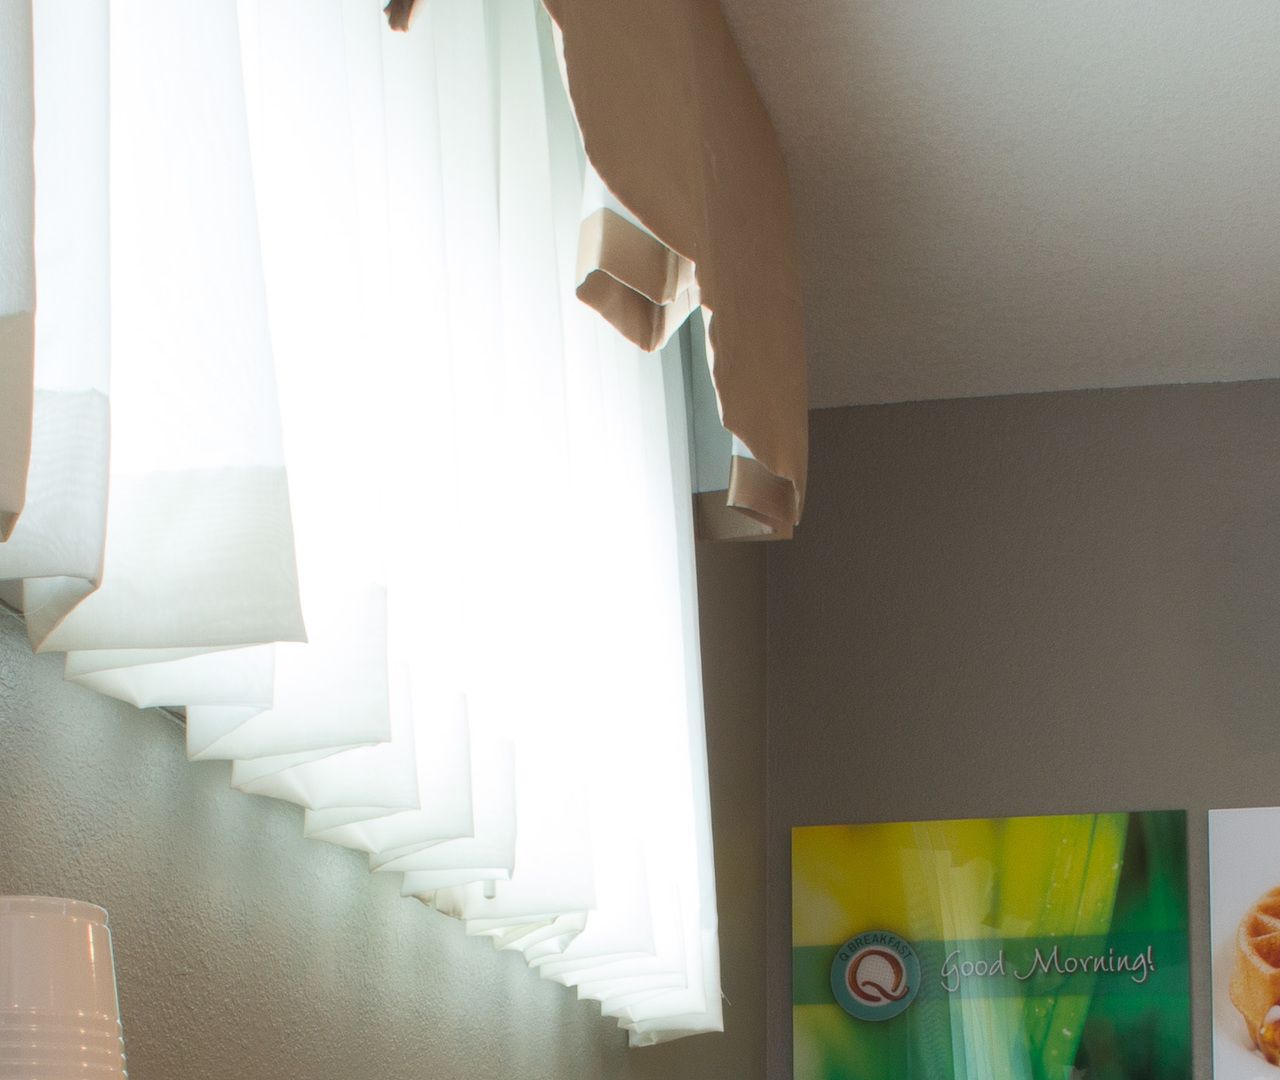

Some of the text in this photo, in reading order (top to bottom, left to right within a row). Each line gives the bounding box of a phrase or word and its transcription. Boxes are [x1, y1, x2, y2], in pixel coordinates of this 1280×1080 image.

[848, 933, 913, 960] BREAKFAST
[941, 945, 1155, 992] Good Morning!
